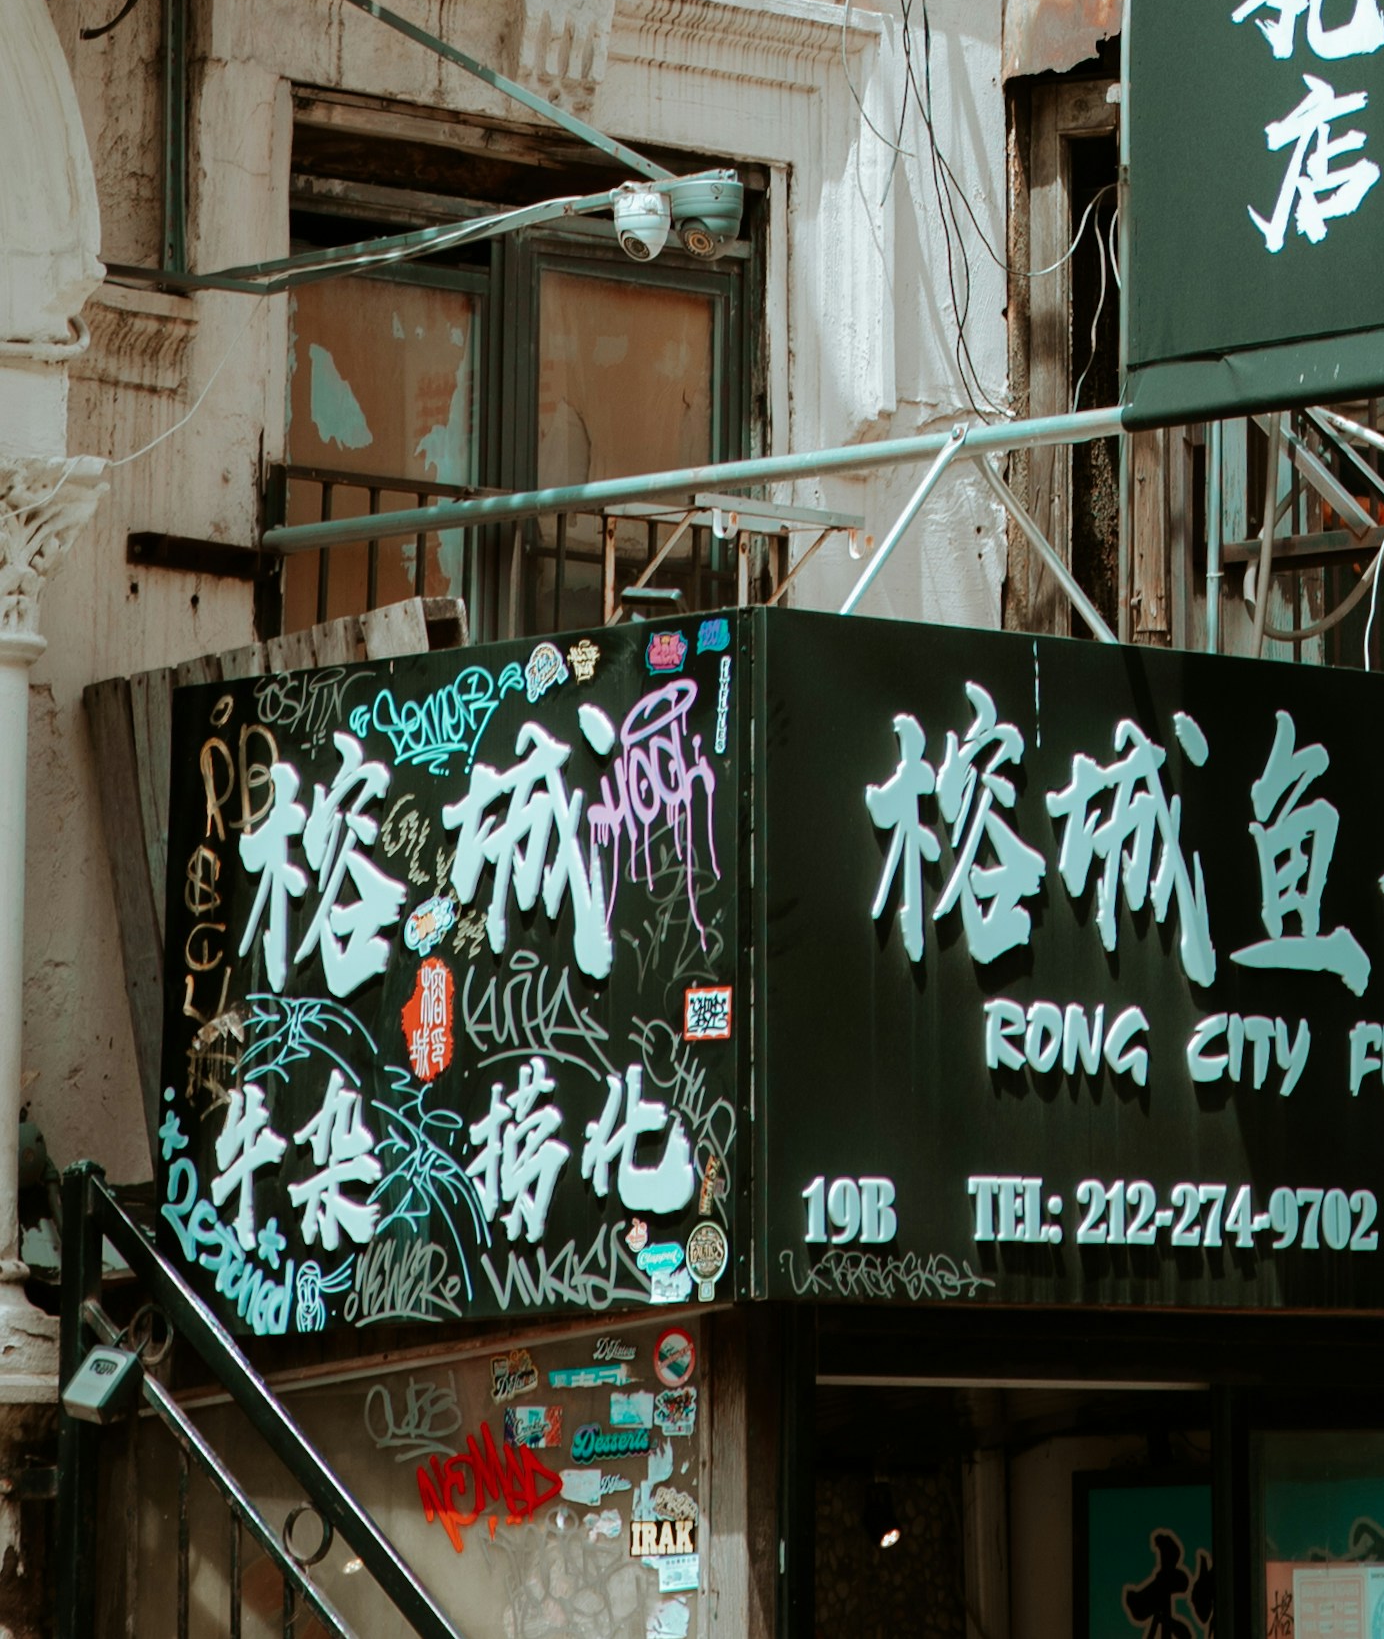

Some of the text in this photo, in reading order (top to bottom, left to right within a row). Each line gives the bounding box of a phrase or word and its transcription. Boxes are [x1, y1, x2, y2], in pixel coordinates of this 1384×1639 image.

[239, 704, 615, 997] 榕城
[984, 998, 1149, 1086] RONG
[1187, 1011, 1310, 1097] CITY
[802, 1176, 897, 1243] 19B
[968, 1176, 1379, 1252] TEL: 212-274-9702
[632, 1522, 693, 1557] IRAK
